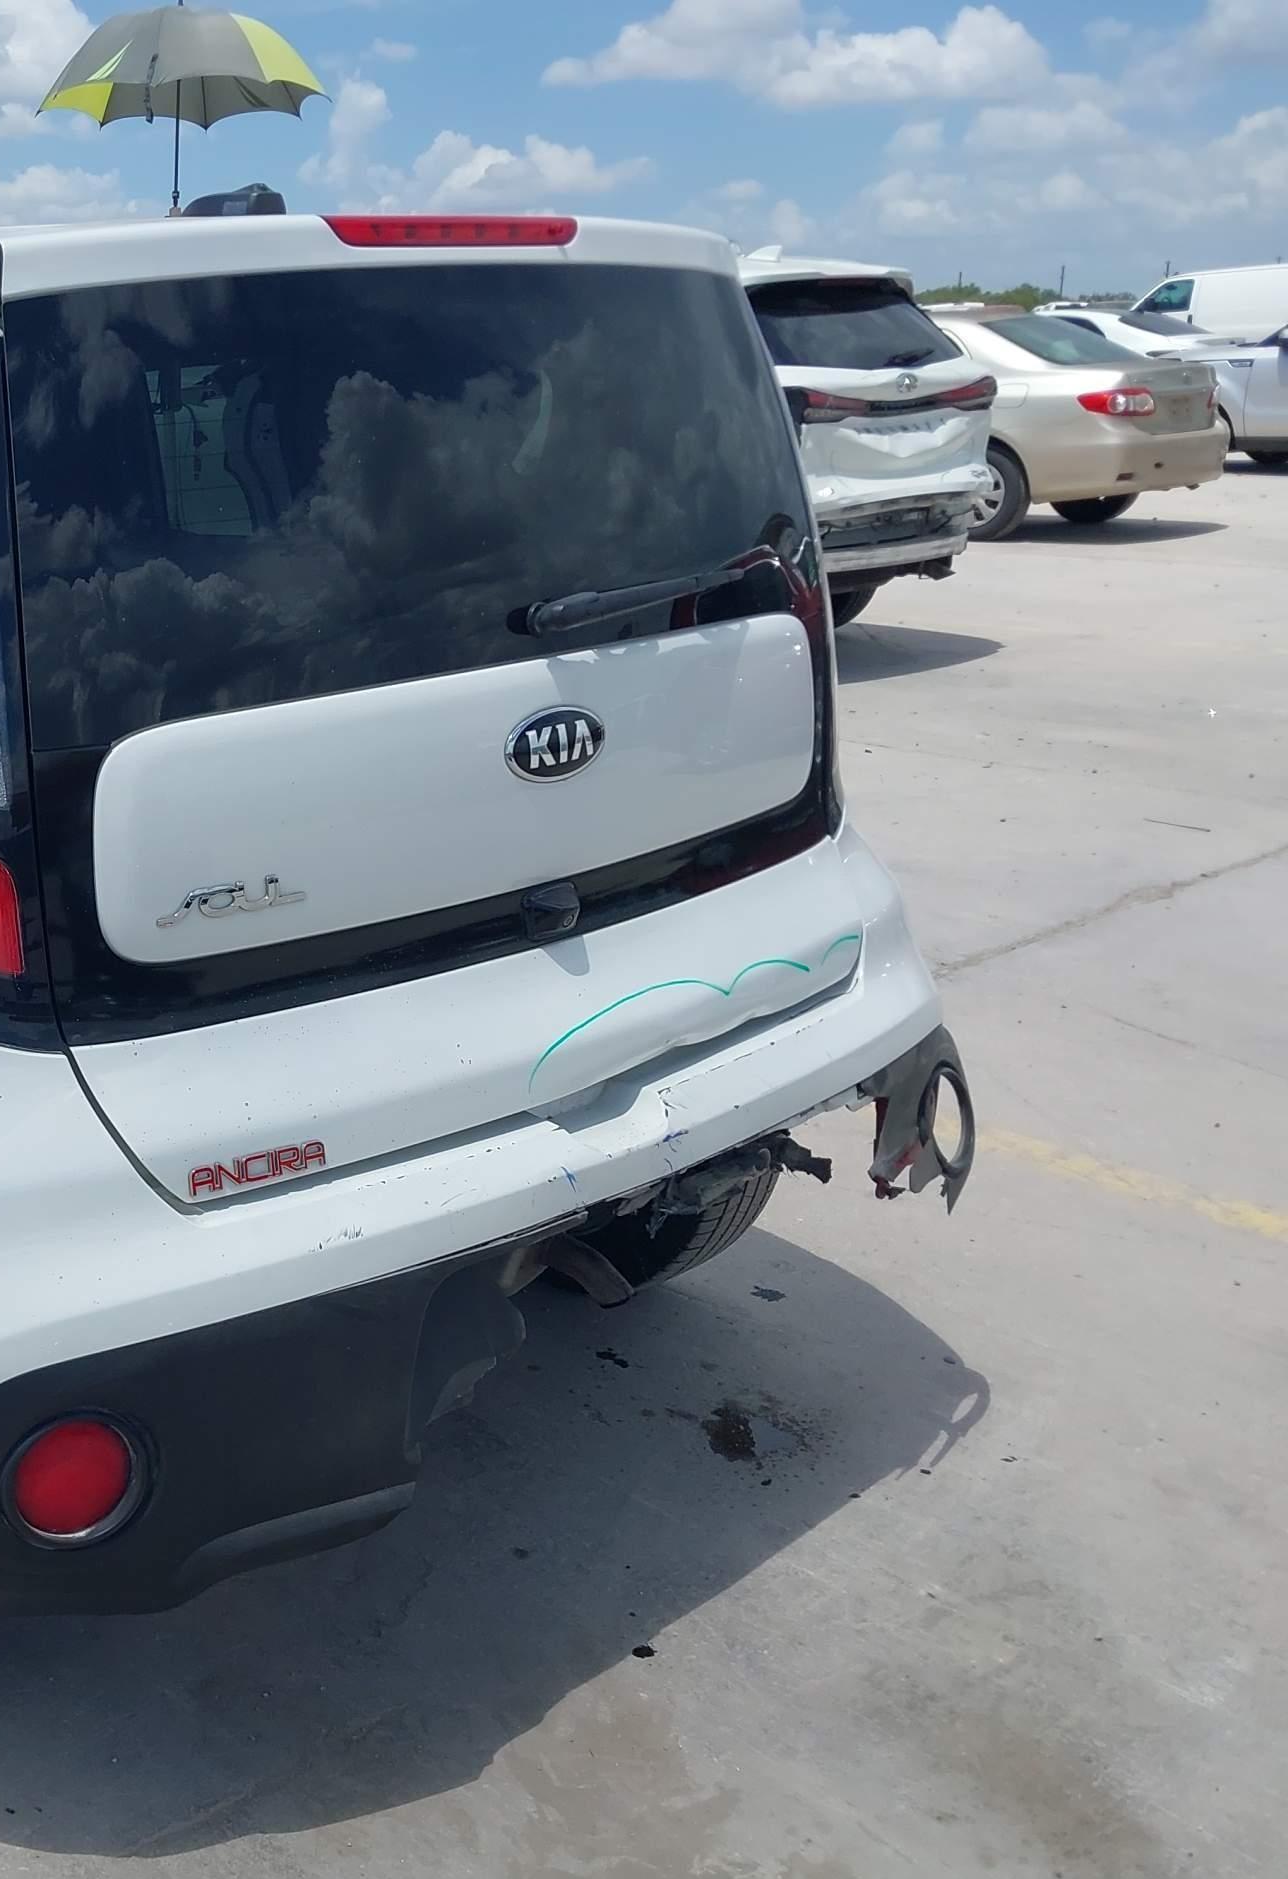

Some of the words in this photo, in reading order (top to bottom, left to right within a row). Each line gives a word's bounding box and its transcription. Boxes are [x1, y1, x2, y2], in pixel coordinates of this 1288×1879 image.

[525, 719, 594, 769] KIA
[156, 874, 306, 928] SOUL
[188, 1138, 328, 1197] ANCIRA
